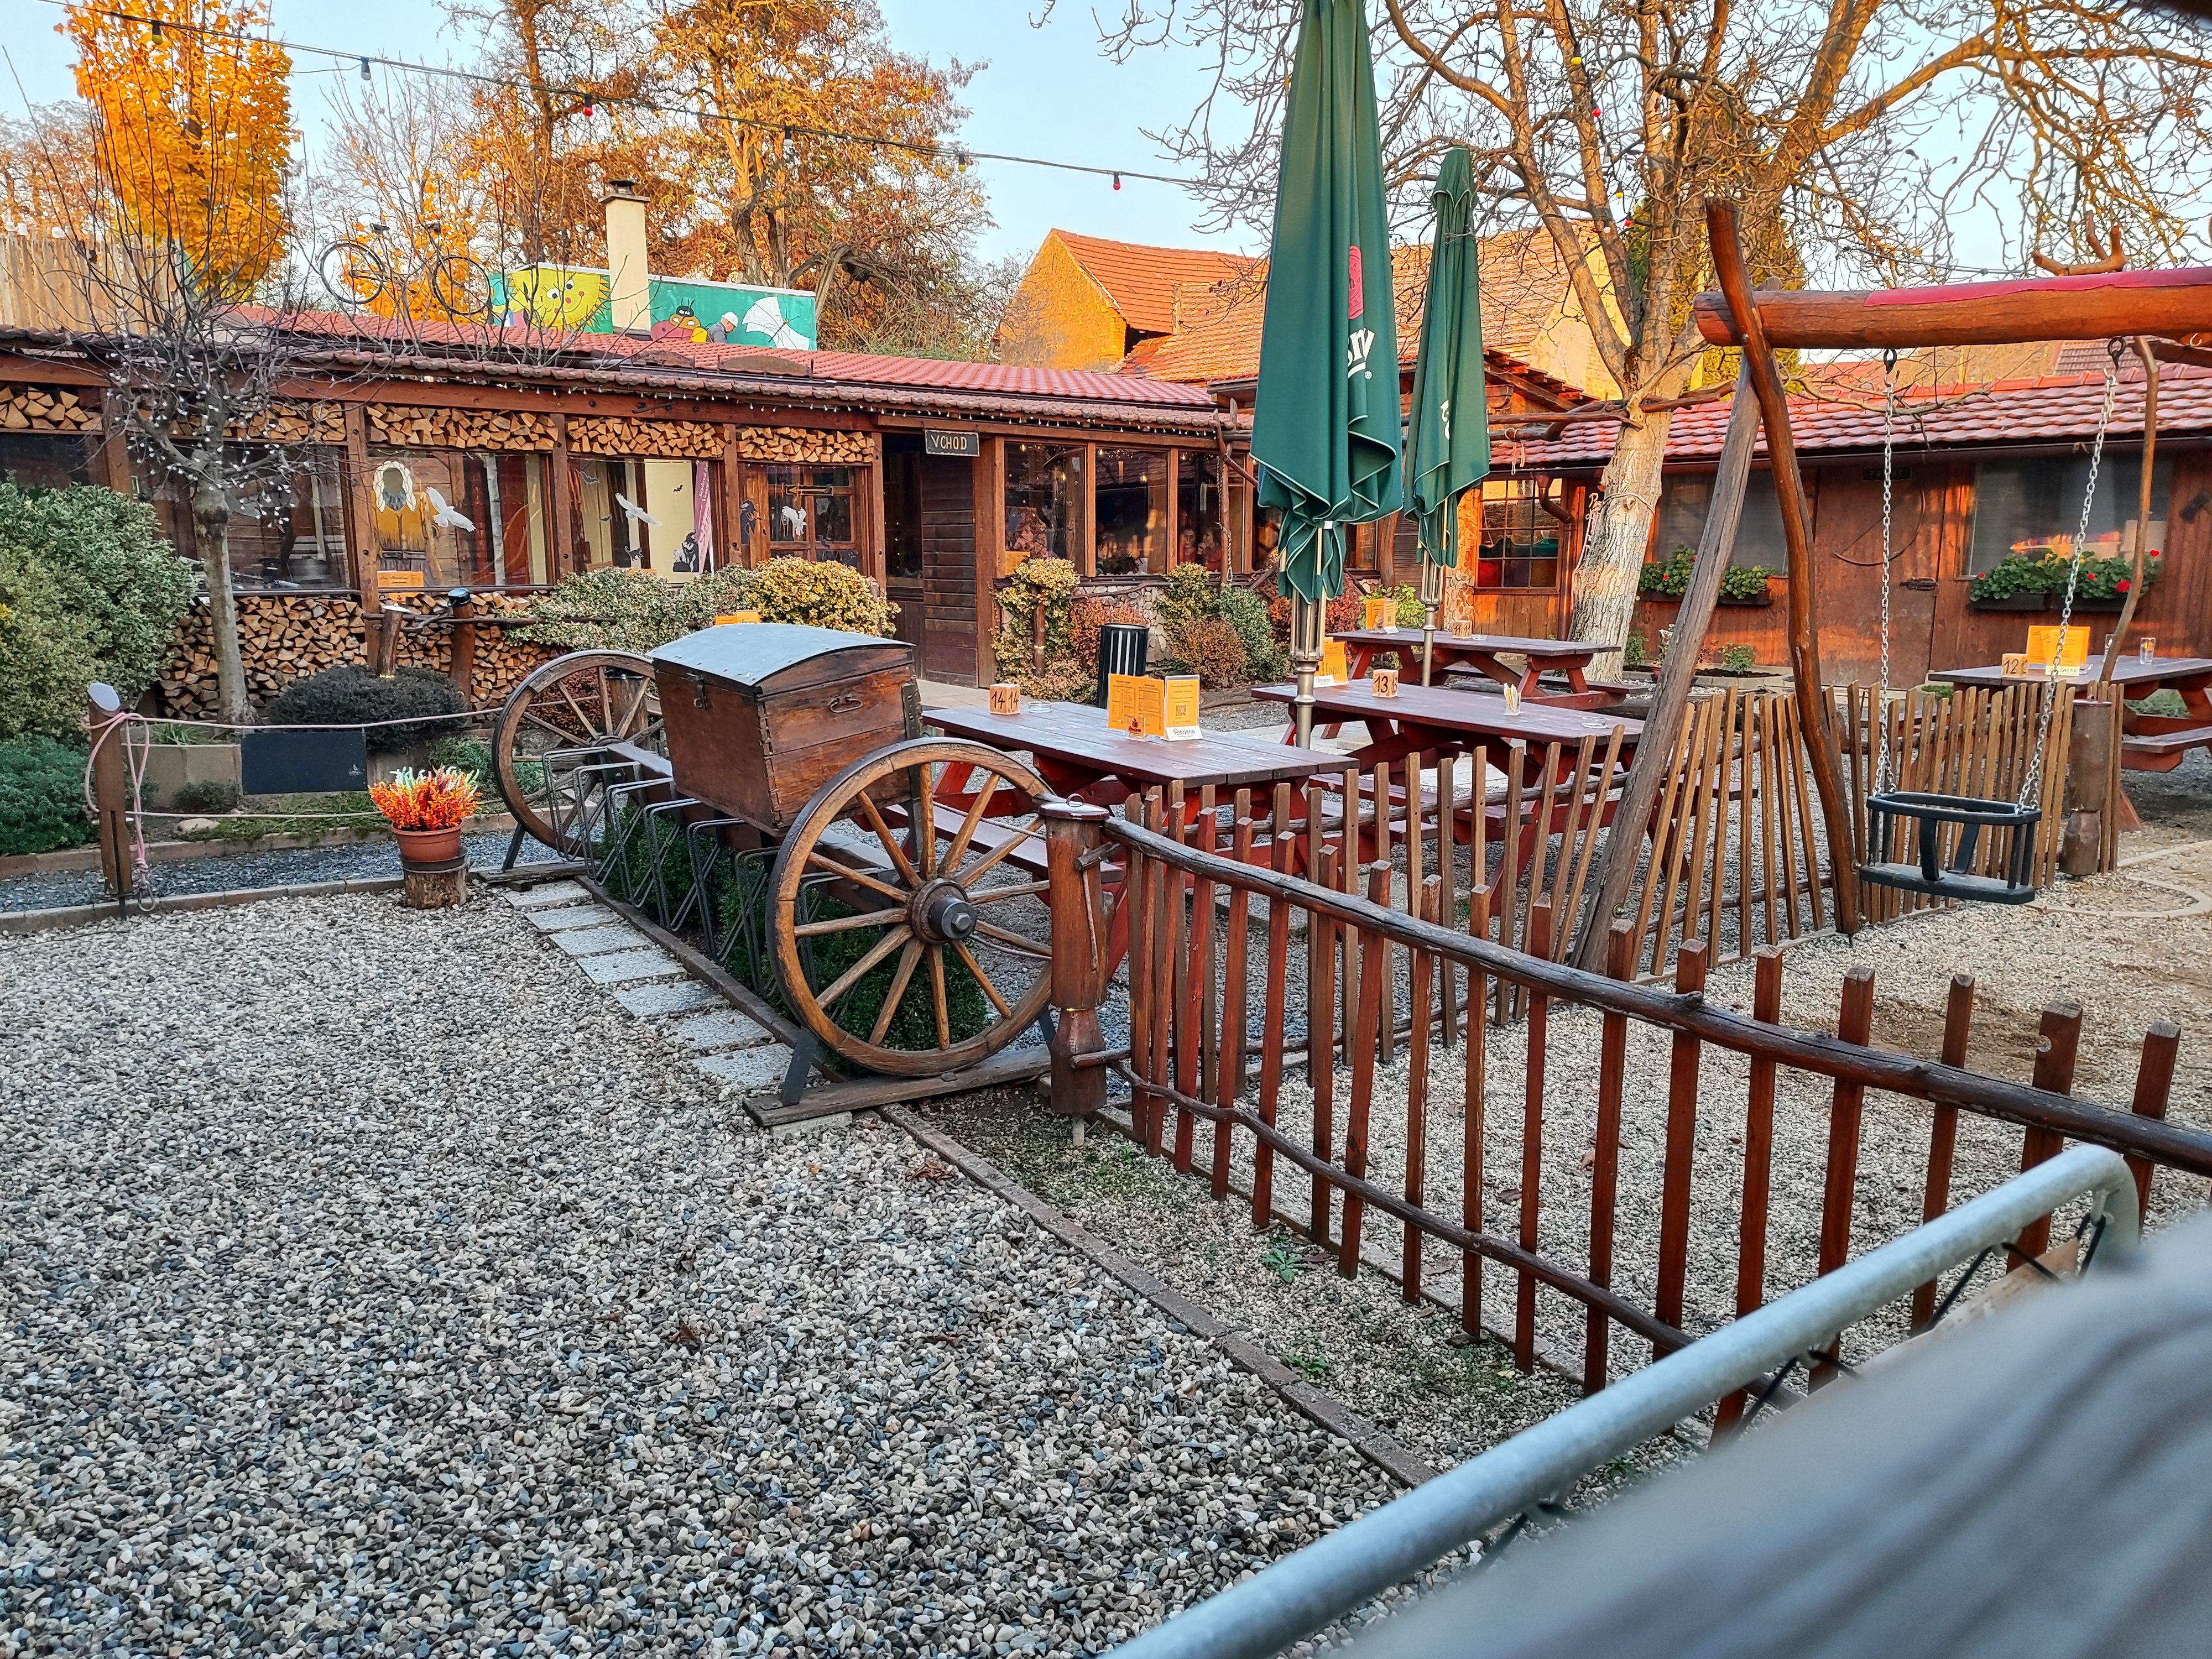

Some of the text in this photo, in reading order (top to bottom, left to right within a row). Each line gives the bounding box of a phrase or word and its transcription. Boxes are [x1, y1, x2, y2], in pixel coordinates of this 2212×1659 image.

[930, 435, 967, 450] VCHOD
[1454, 625, 1460, 635] 11
[2003, 659, 2018, 674] 12
[1374, 675, 1389, 693] 13
[991, 691, 1005, 709] 14
[1008, 691, 1019, 709] 14
